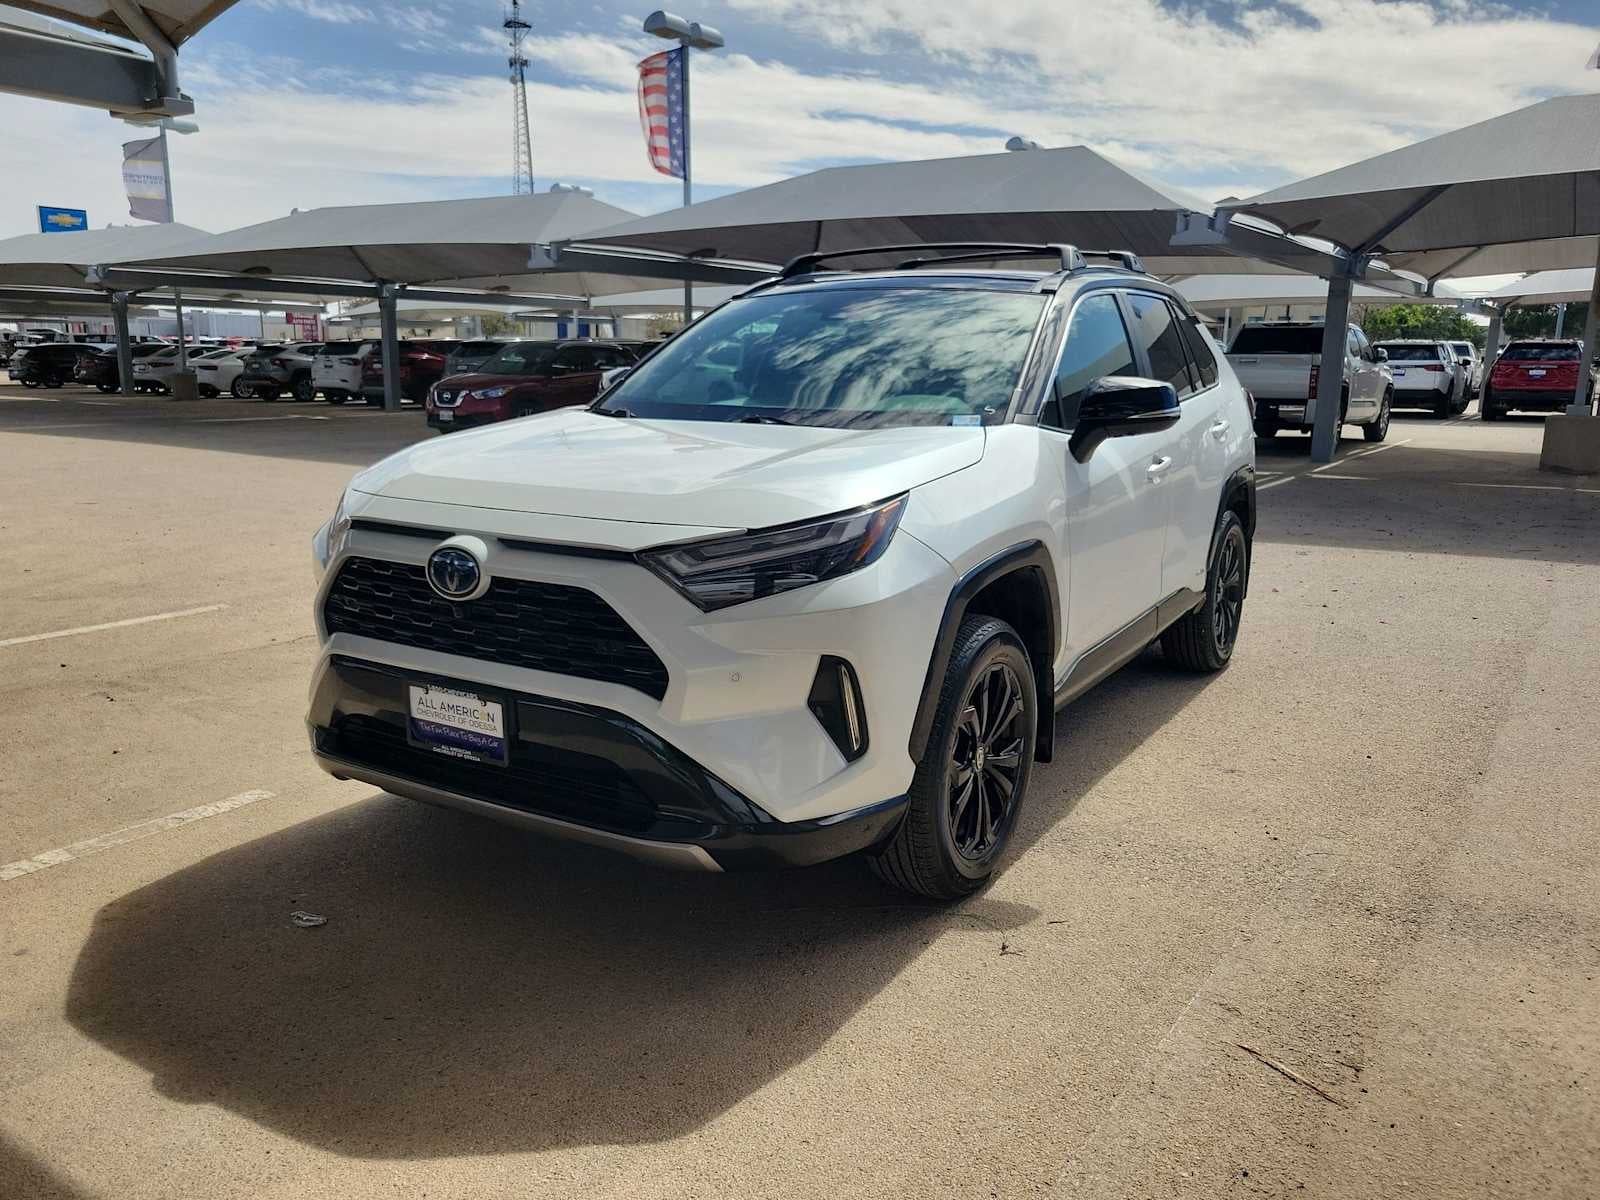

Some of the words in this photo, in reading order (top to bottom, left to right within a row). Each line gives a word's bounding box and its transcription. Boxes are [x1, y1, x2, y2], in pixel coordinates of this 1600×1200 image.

[418, 697, 437, 710] ALL
[417, 708, 457, 722] CHEVROLET
[457, 717, 468, 726] OF
[470, 720, 497, 731] ODESSA
[469, 736, 482, 746] Buy
